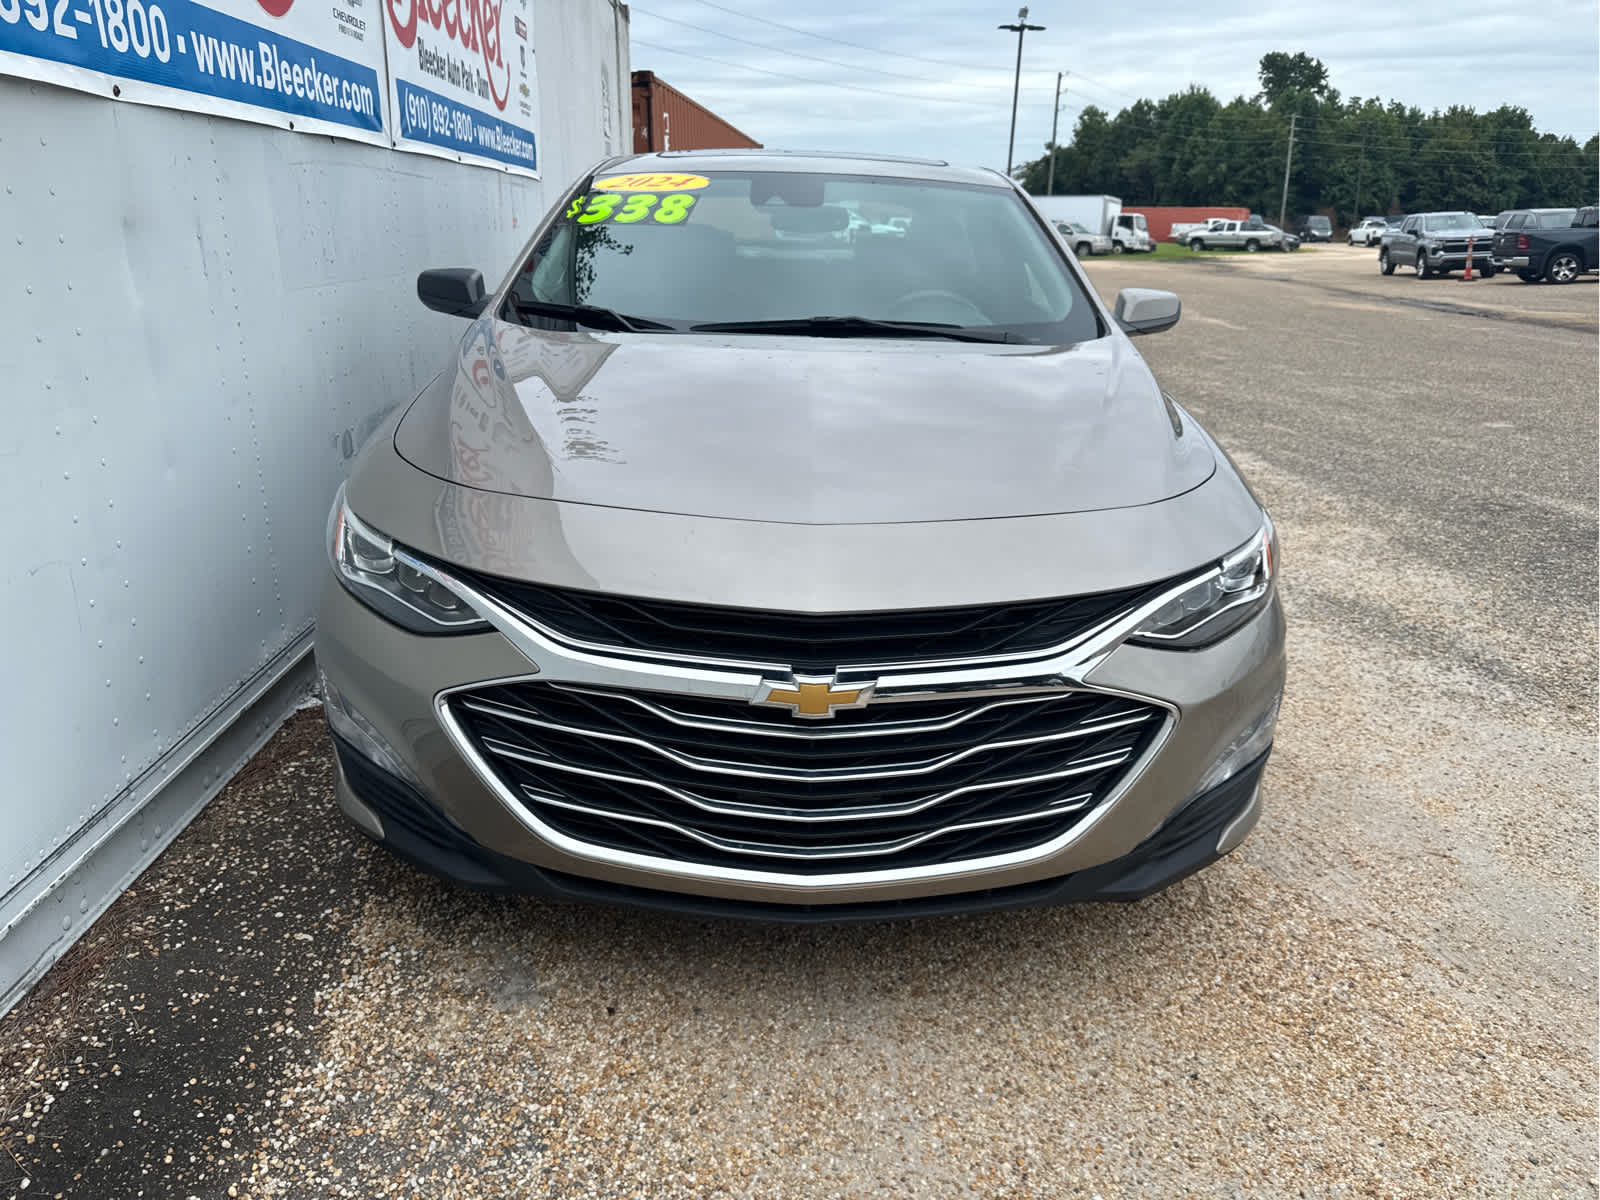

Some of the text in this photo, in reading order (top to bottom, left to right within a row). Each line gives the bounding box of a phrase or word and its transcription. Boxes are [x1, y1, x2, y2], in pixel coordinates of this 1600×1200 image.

[332, 7, 366, 32] CHEVROLET
[190, 31, 374, 116] www.Bleecker.com
[417, 36, 446, 80] Bleecker
[447, 52, 461, 88] Auto
[461, 60, 475, 94] Park
[404, 87, 534, 161] (910) 892-1800 www.Bleecker.com
[606, 176, 697, 188] 2024
[566, 193, 697, 224] $338
